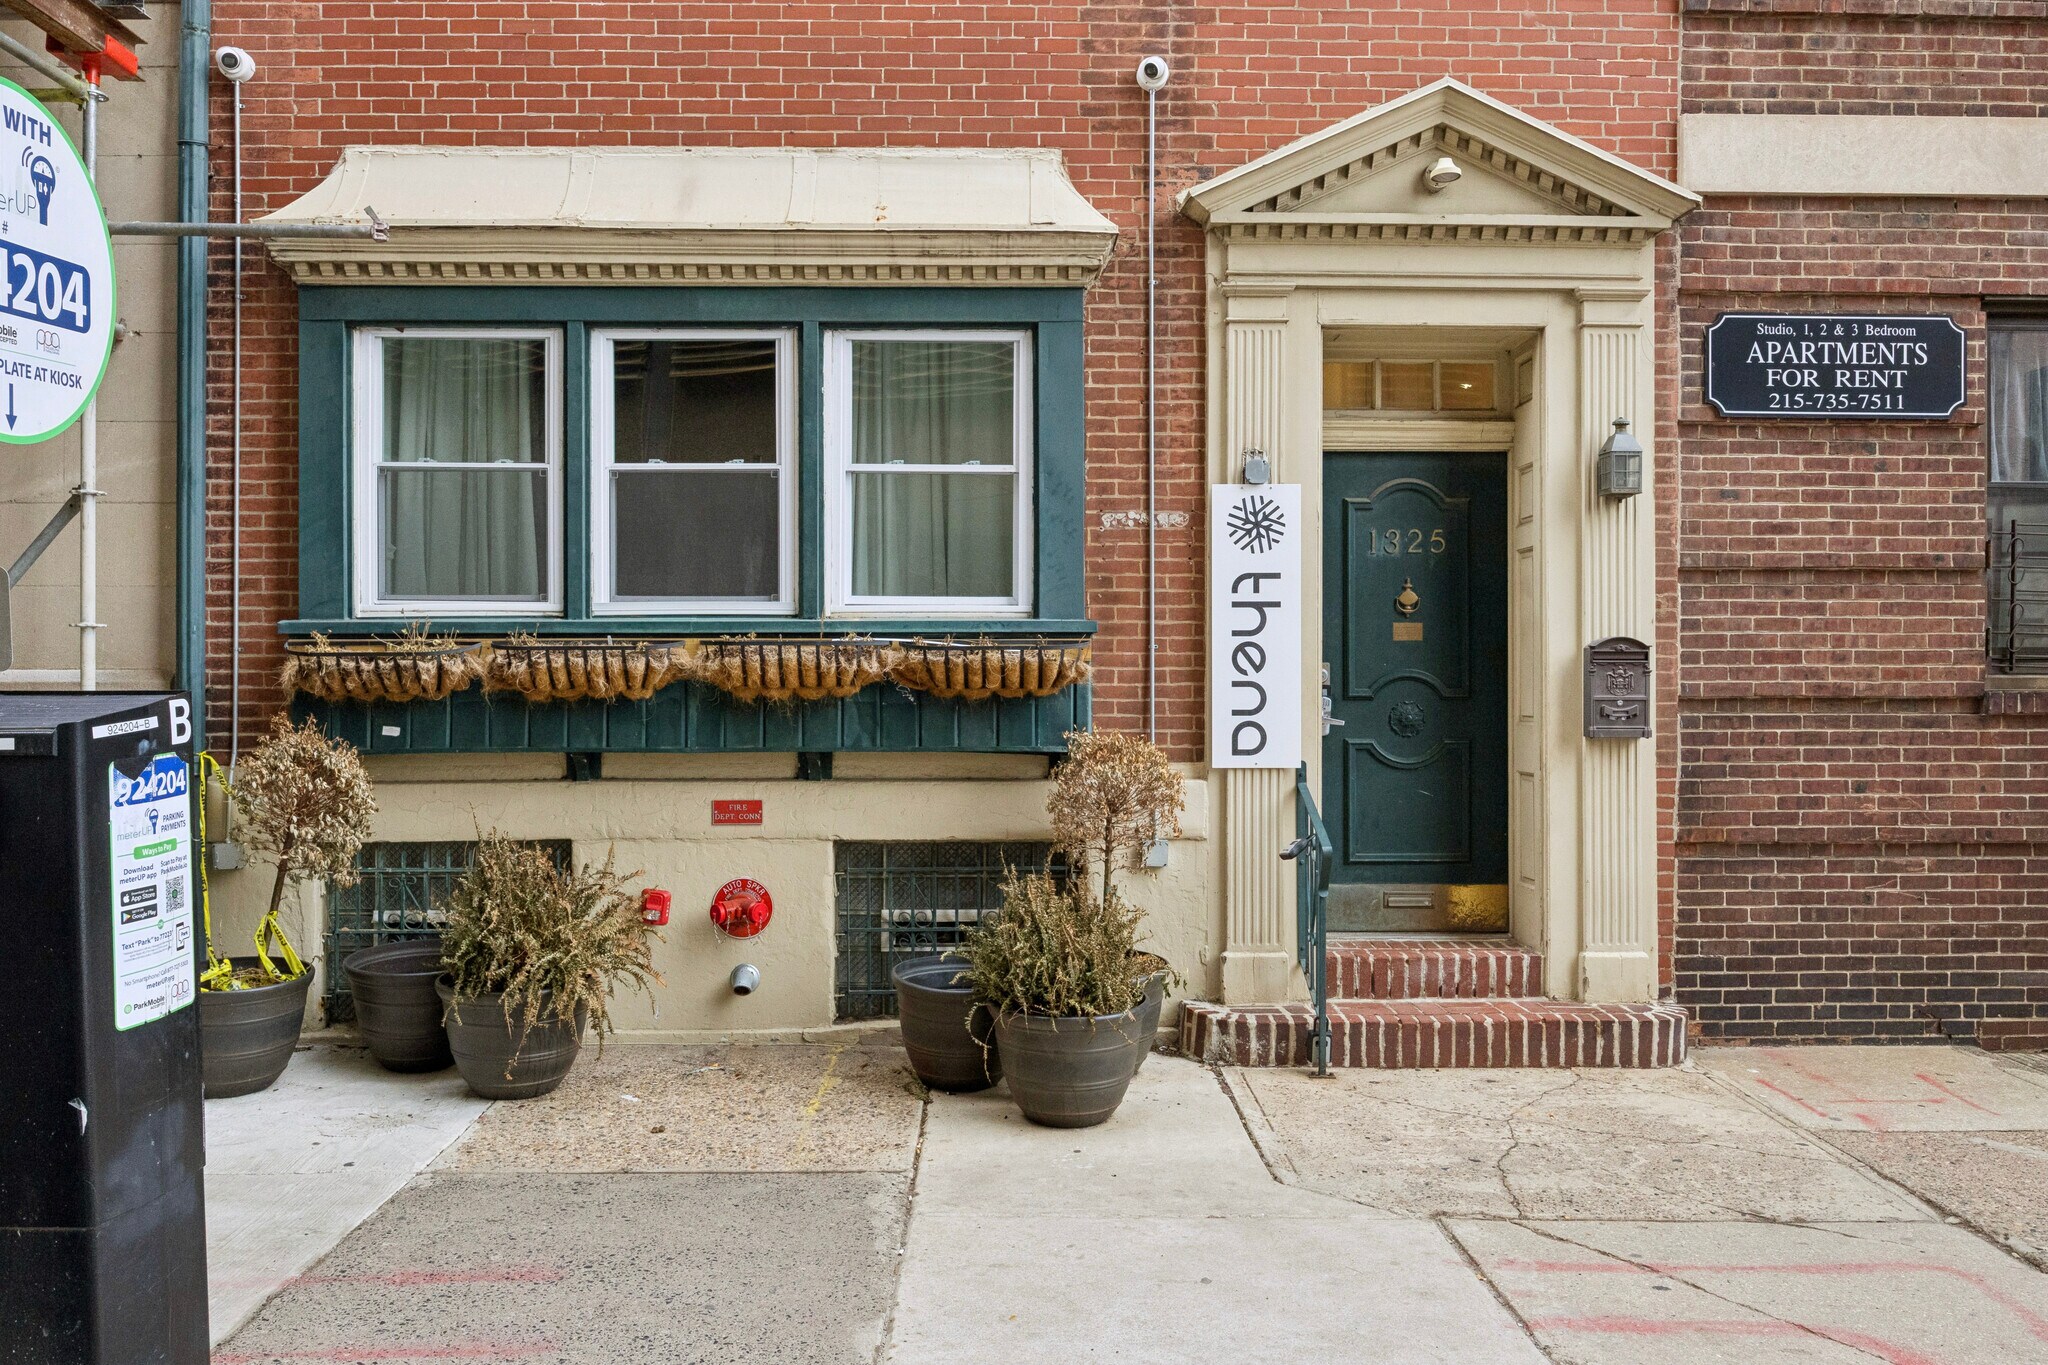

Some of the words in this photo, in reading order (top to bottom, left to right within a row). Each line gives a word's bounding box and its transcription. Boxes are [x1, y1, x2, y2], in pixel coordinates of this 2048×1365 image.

[3, 104, 51, 147] WITH
[2, 220, 9, 234] #
[1756, 322, 1796, 337] Studio,
[1803, 323, 1814, 337] 1,
[1820, 323, 1828, 336] 2
[1833, 323, 1845, 336] &
[1851, 323, 1859, 336] 3
[1865, 323, 1917, 337] Bedroom
[1746, 340, 1928, 366] APARTMENTS
[34, 366, 48, 382] AT
[50, 369, 82, 389] KIOSK
[1766, 369, 1820, 388] FOR
[1834, 369, 1908, 389] RENT
[1769, 393, 1905, 410] 215-735-7511
[1368, 527, 1446, 555] 1325
[107, 719, 151, 736] 924204-B
[168, 698, 192, 746] B
[162, 810, 184, 823] PARKING
[117, 825, 153, 842] meterUP
[160, 819, 187, 833] PAYMENTS
[142, 847, 158, 856] Ways
[163, 843, 172, 851] Pay
[123, 863, 154, 876] Download
[119, 873, 146, 885] meterUP
[146, 872, 158, 880] app
[722, 880, 742, 895] AUTO
[746, 881, 766, 896] SPKR
[131, 895, 142, 903] App
[121, 942, 135, 951] Text
